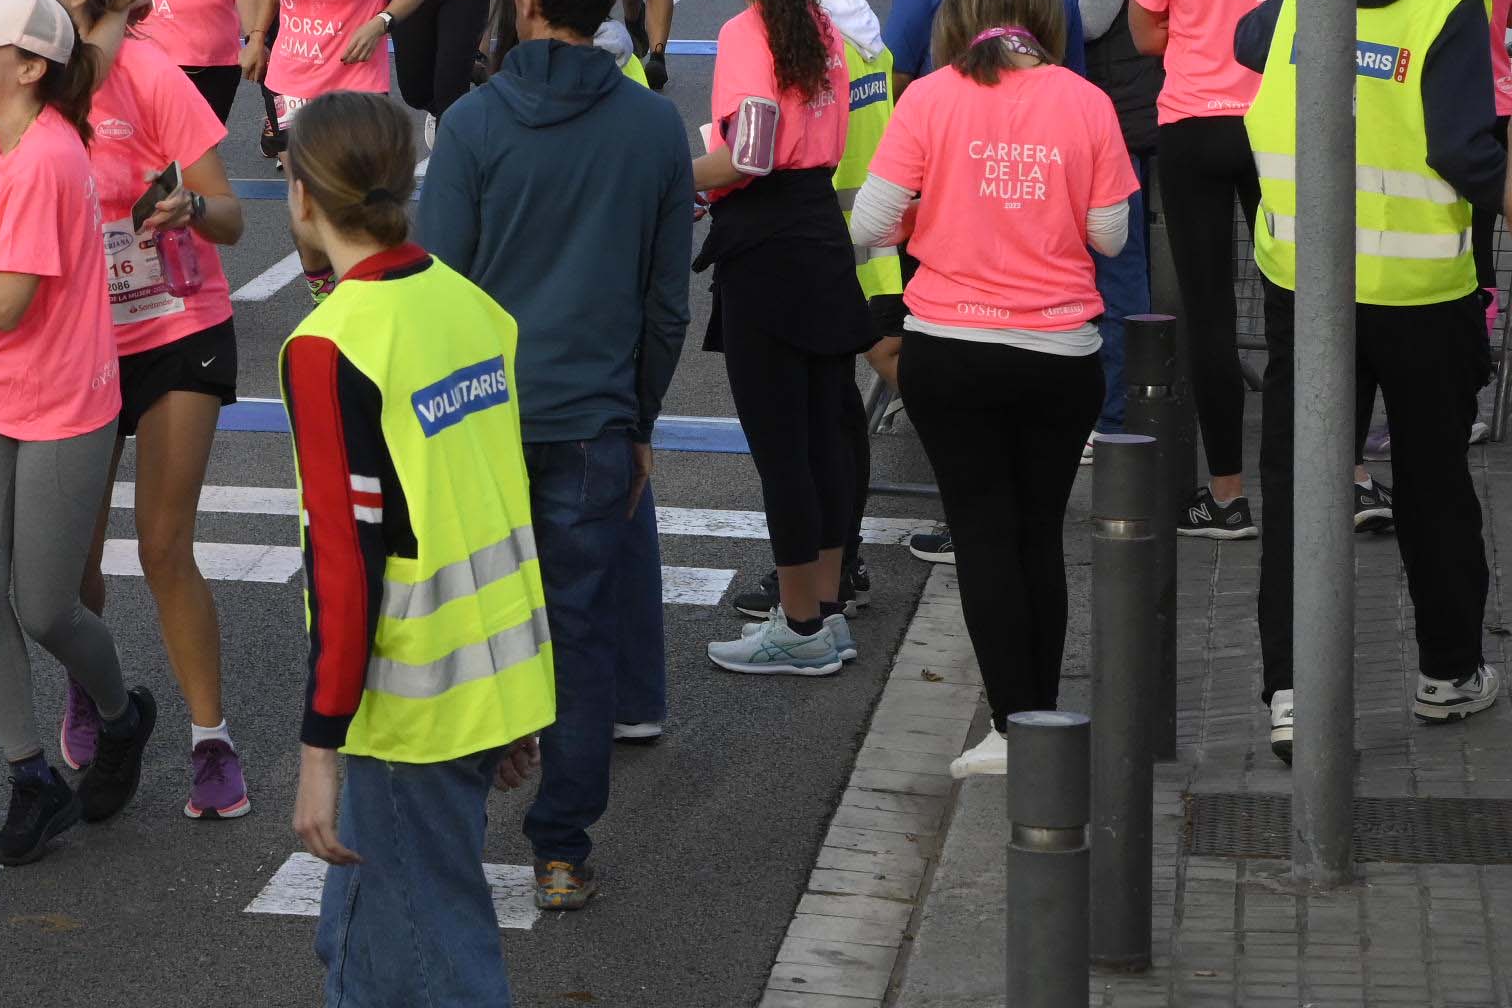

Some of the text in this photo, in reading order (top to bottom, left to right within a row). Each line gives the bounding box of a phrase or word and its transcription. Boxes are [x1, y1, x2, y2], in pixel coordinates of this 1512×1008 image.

[289, 98, 311, 109] 01
[969, 141, 1062, 165] CARRERA
[986, 161, 1043, 181] DE LA
[980, 180, 1045, 200] MUJER
[110, 259, 133, 278] 16
[119, 292, 128, 300] LA
[129, 288, 151, 300] MUJER
[138, 297, 174, 311] Santander
[957, 302, 1010, 320] OYSHO
[418, 370, 506, 423] VOLUTARIS
